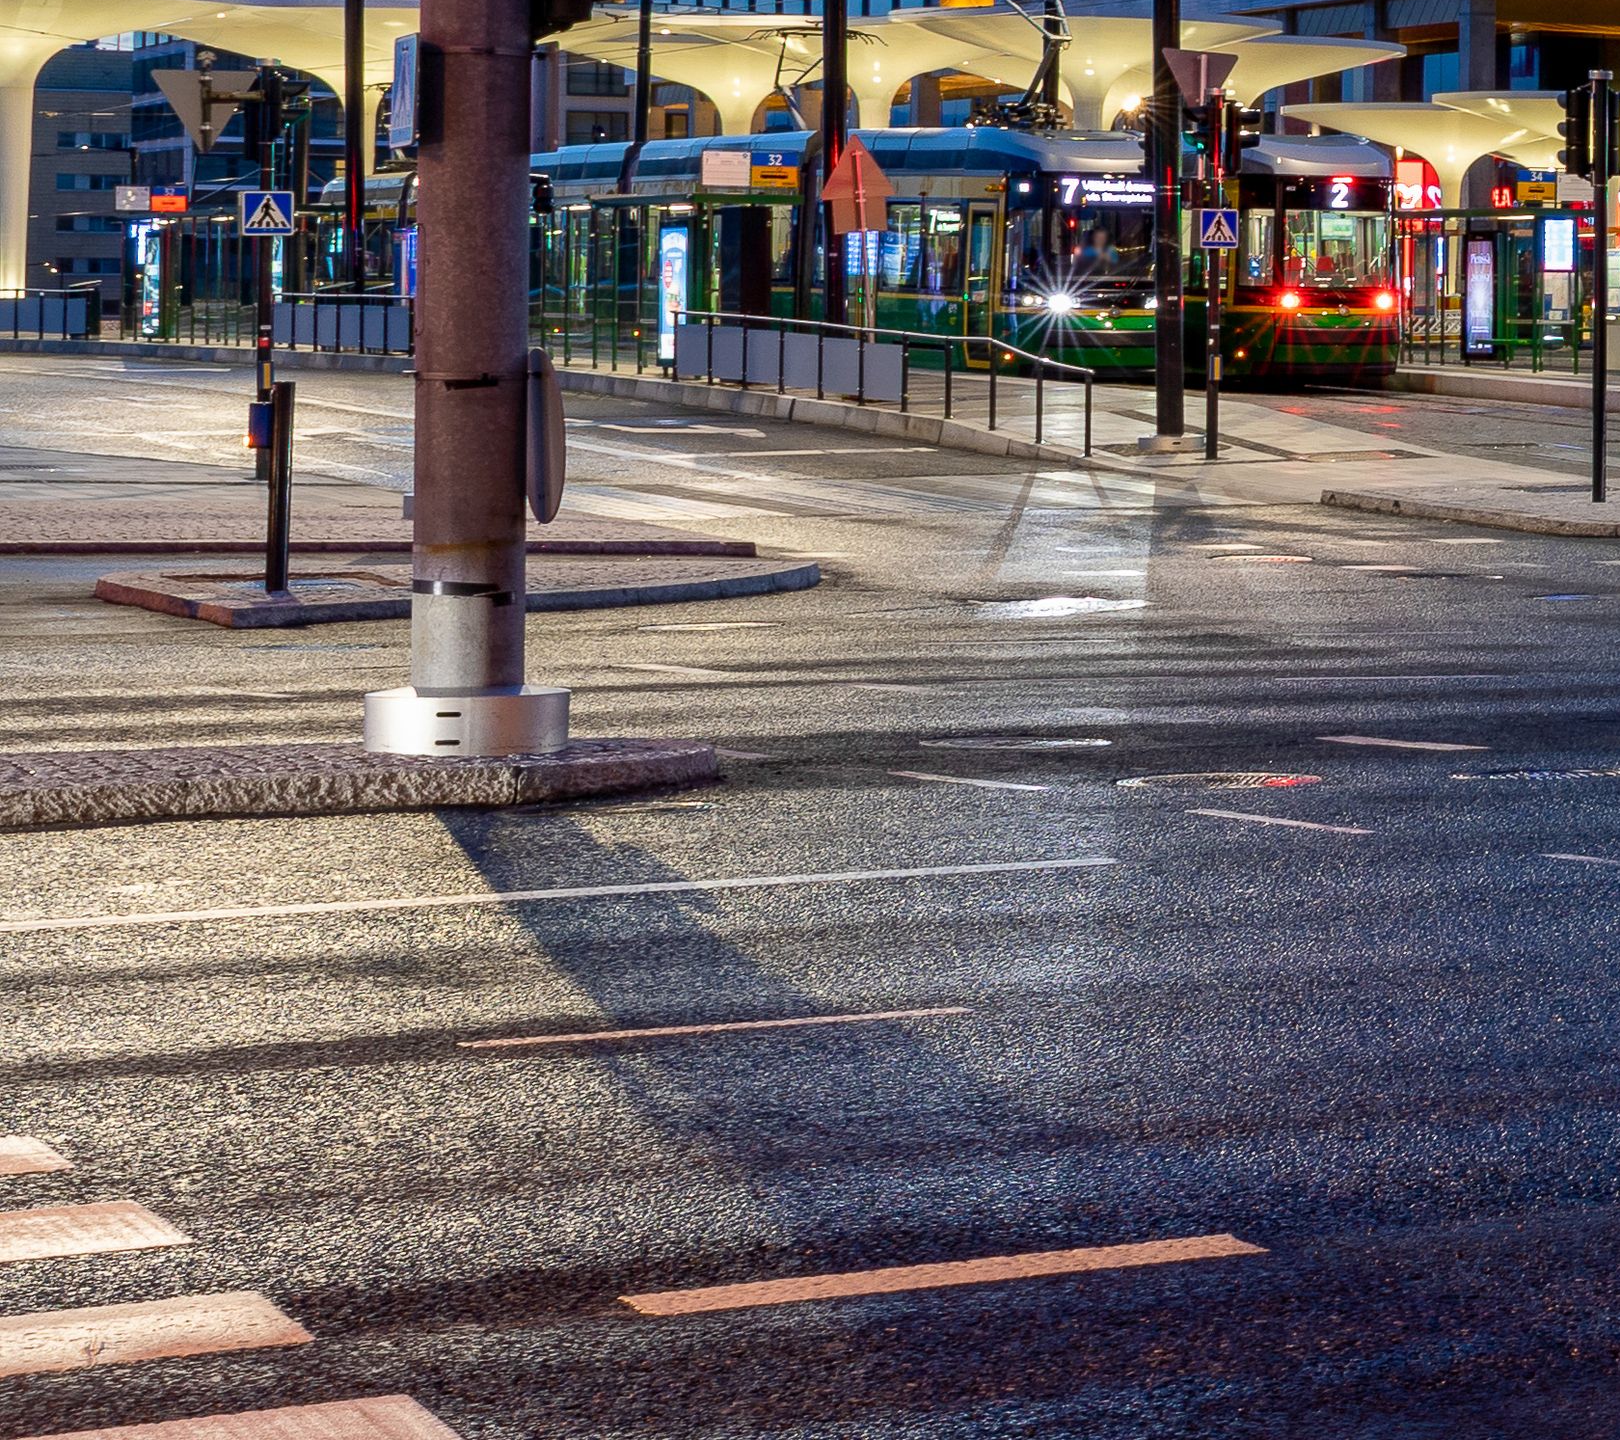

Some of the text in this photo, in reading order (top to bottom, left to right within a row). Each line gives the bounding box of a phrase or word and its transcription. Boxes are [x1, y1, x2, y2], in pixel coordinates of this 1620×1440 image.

[768, 154, 783, 166] 32
[1531, 172, 1543, 181] 34
[1061, 178, 1080, 204] 7
[1330, 183, 1349, 208] 2
